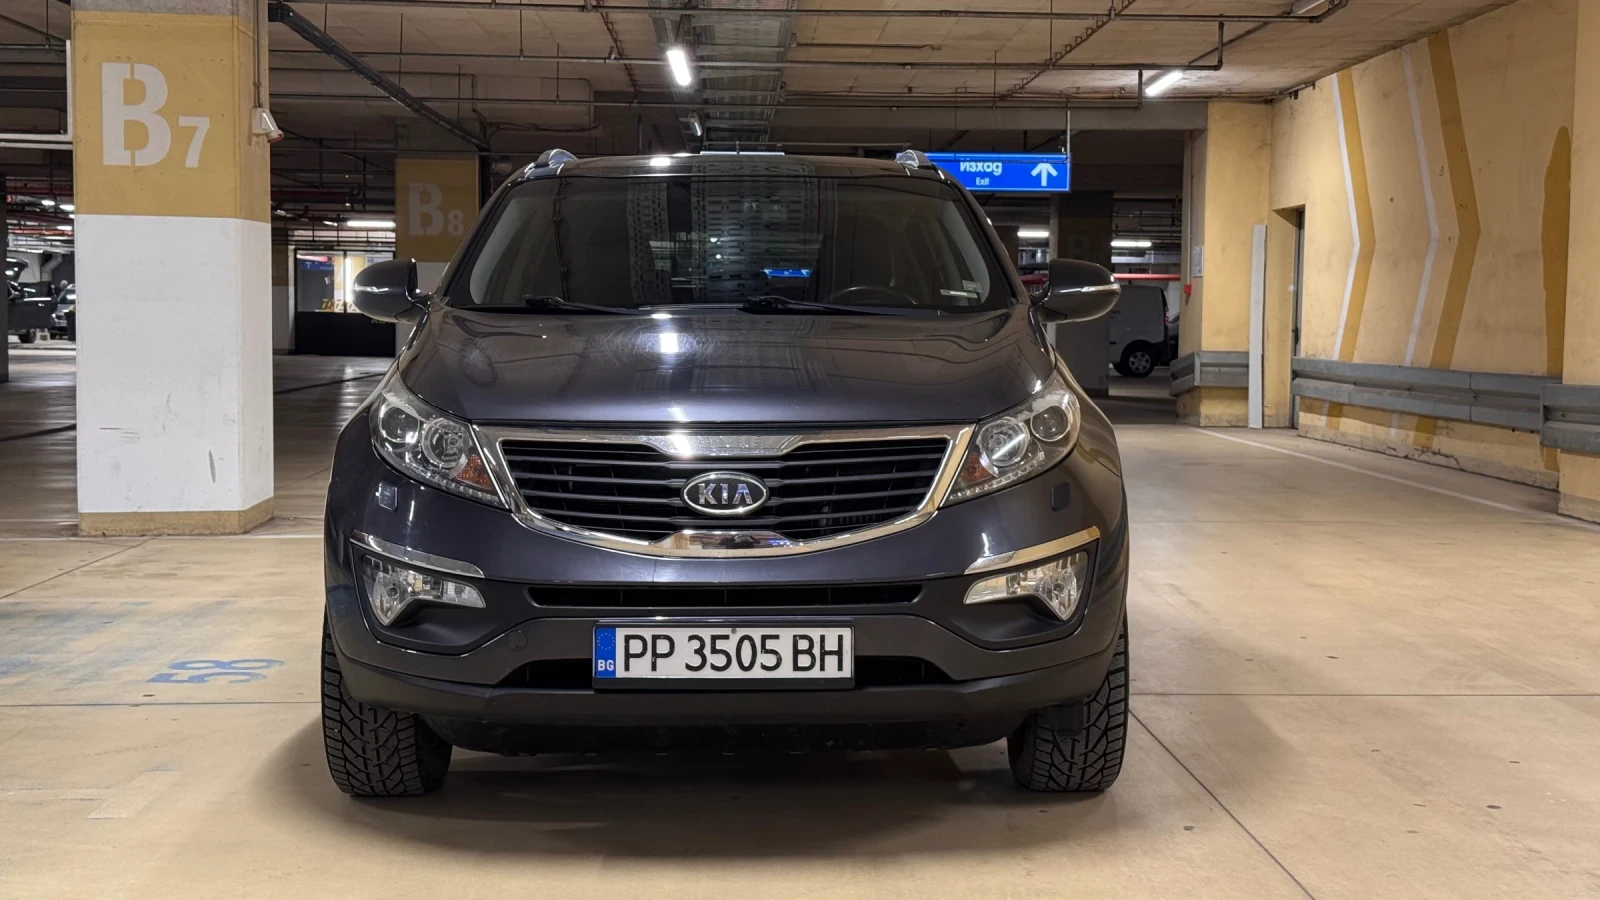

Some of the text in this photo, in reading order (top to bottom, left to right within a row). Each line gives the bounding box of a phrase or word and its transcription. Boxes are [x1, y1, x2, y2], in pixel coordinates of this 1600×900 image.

[976, 177, 990, 186] Exit
[698, 483, 753, 505] KIA
[623, 634, 844, 672] PP 3505 BH
[145, 658, 285, 684] 58
[597, 659, 615, 671] BG
